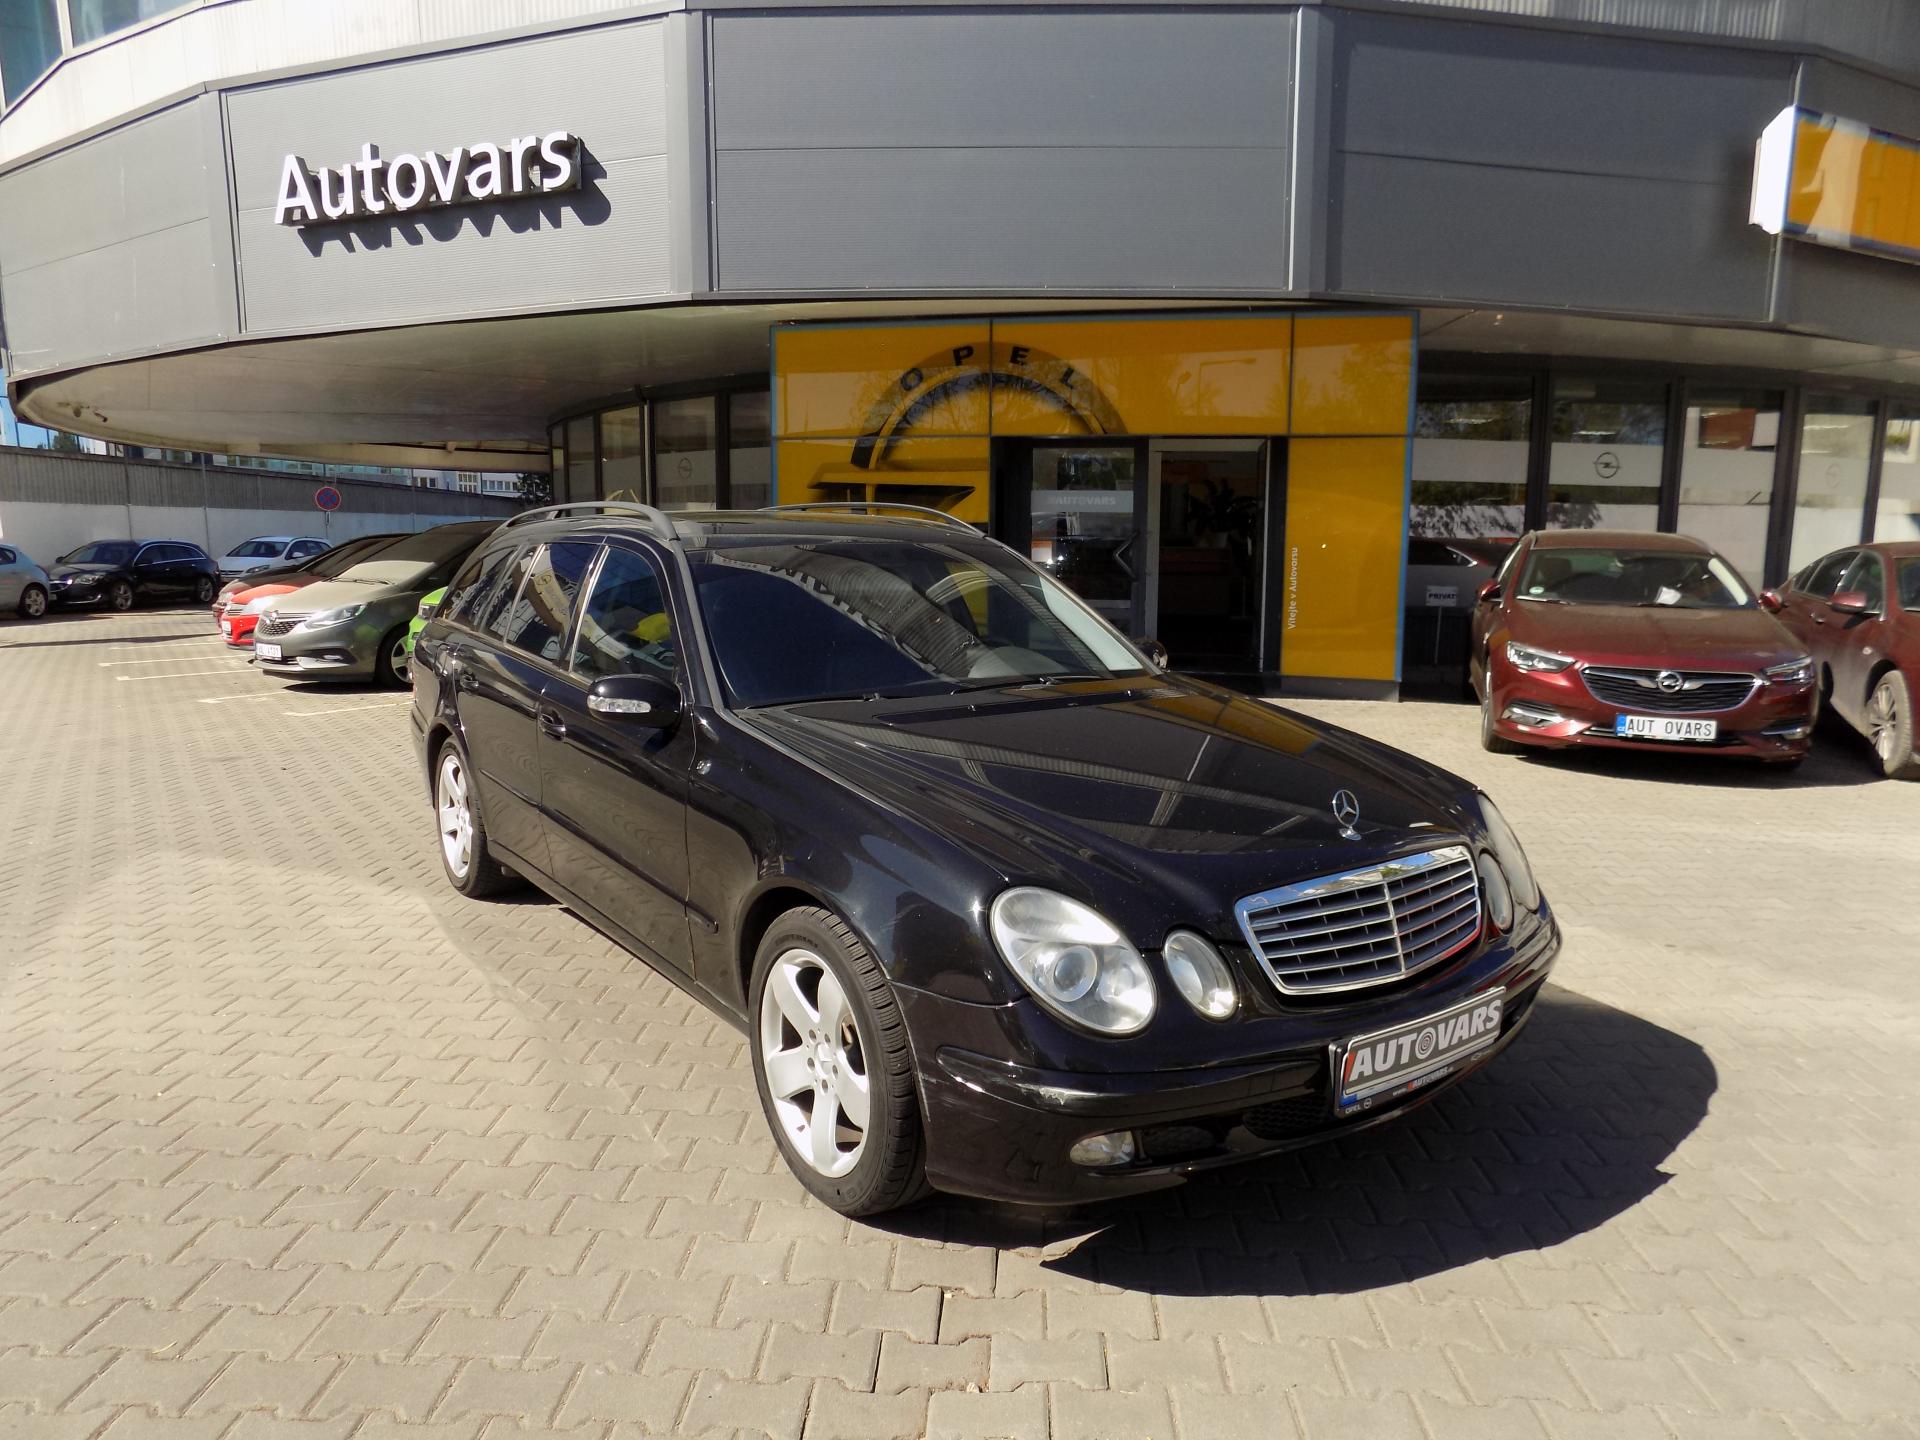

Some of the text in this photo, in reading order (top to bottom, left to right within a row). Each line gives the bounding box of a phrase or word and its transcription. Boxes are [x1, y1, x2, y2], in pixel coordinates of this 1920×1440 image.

[275, 131, 571, 224] Autovars
[900, 345, 1075, 391] OPEL
[1055, 496, 1117, 505] AUTOVARS
[1627, 718, 1712, 737] AUT OVARS
[1349, 1000, 1502, 1082] AUTOVARS
